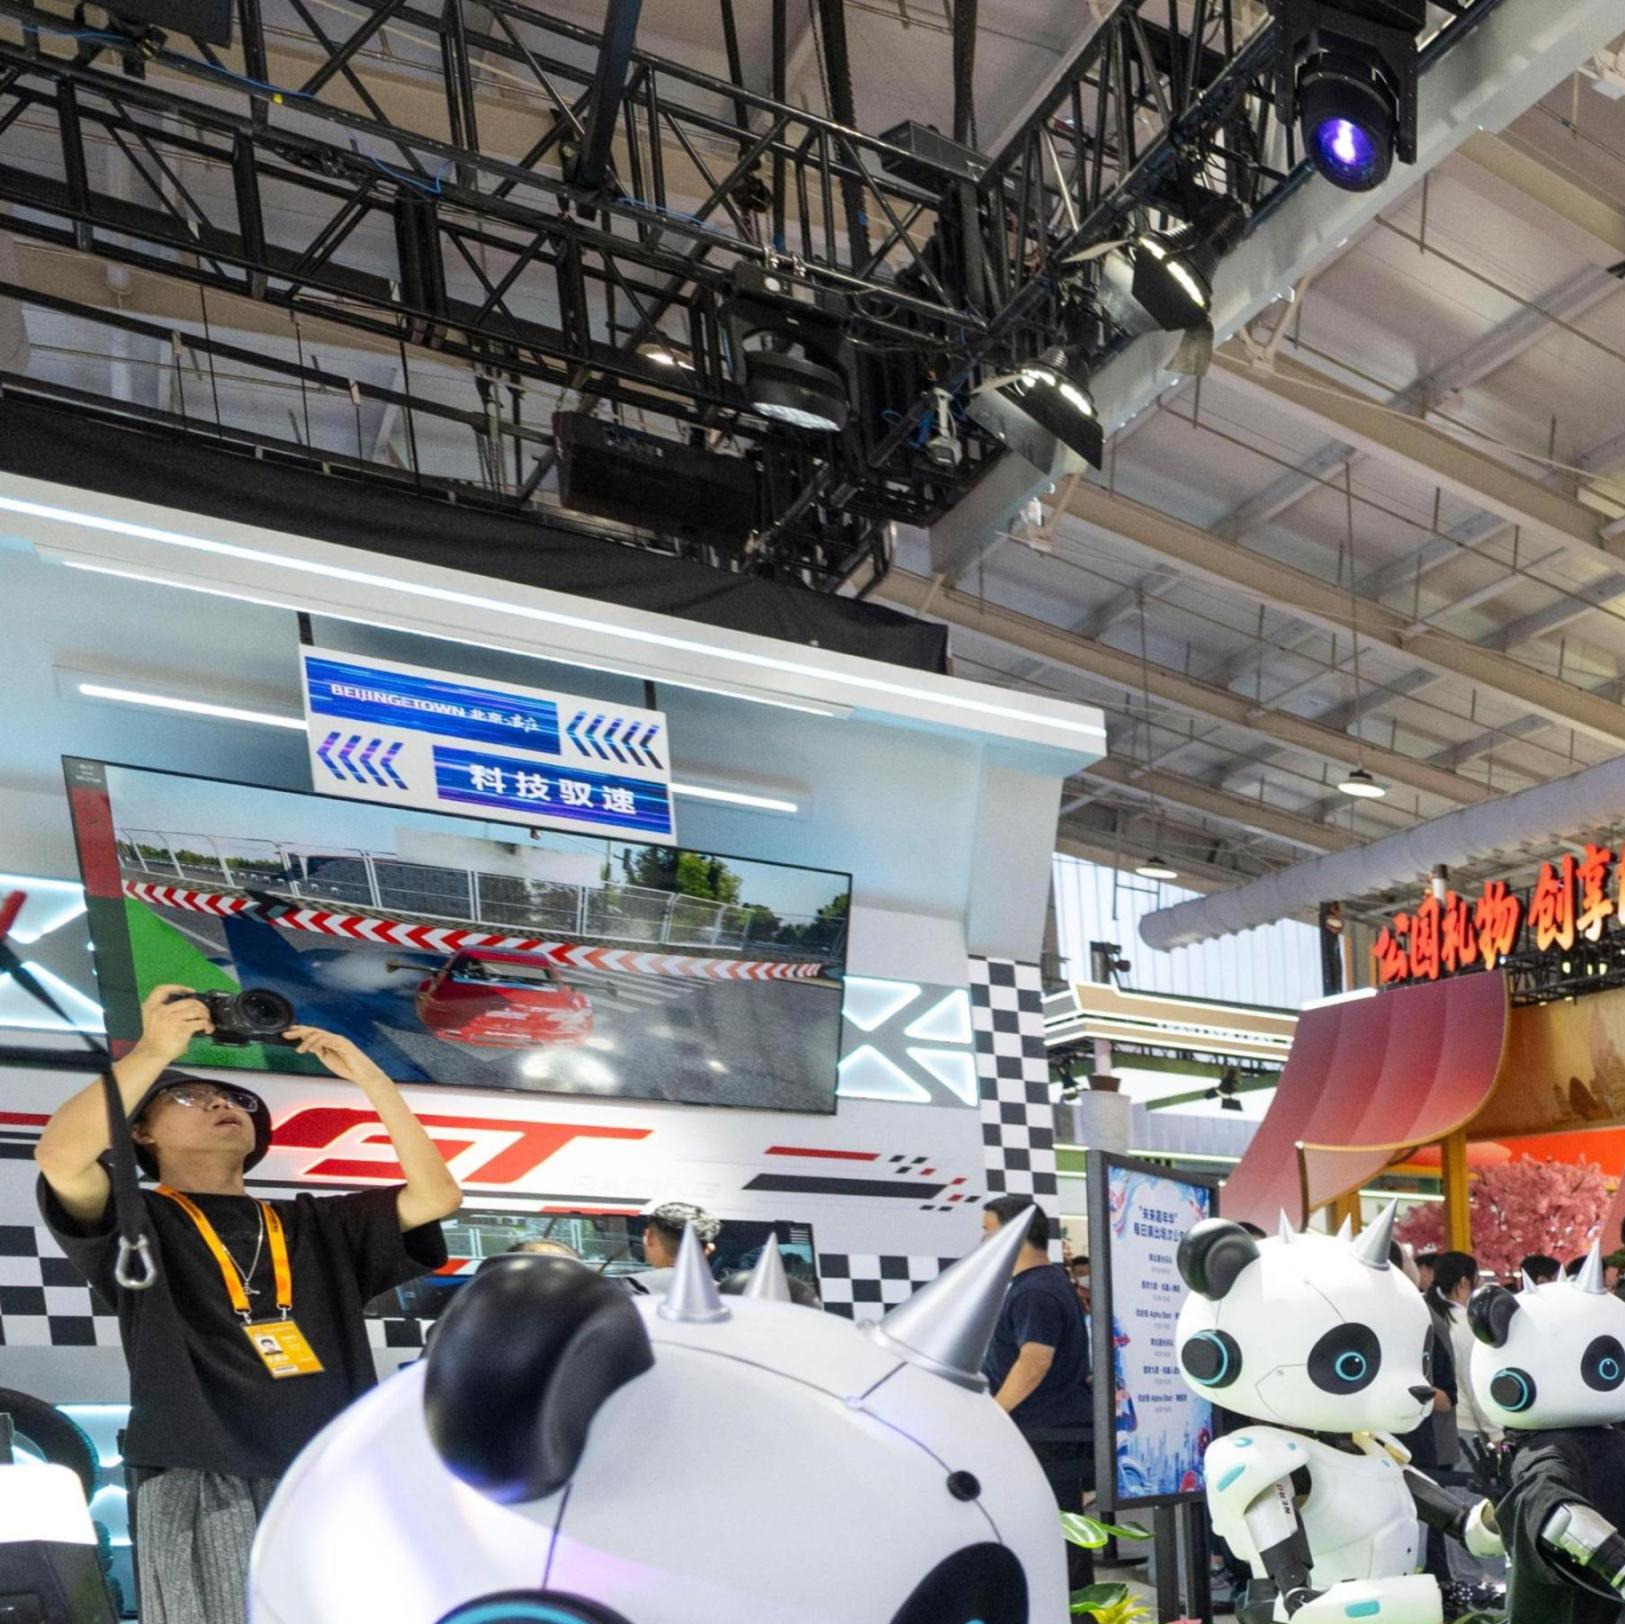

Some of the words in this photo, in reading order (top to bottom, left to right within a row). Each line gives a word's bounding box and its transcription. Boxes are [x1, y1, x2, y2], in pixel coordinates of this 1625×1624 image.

[468, 763, 637, 815] 科技驭速
[1371, 879, 1523, 985] 公园礼物
